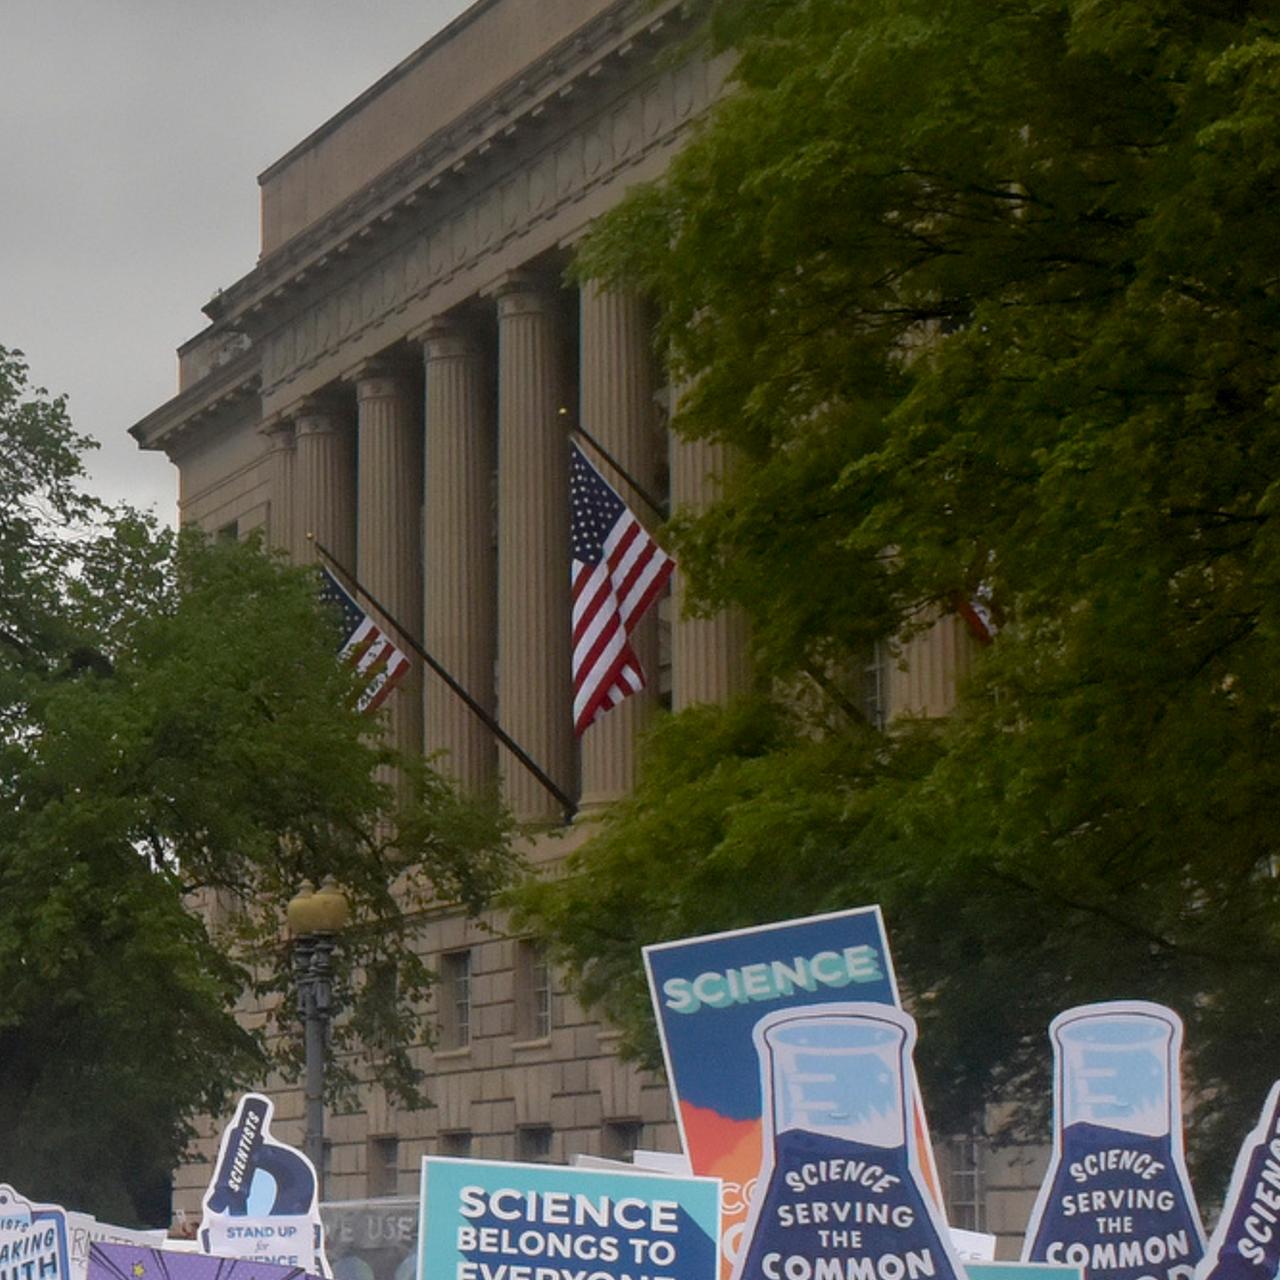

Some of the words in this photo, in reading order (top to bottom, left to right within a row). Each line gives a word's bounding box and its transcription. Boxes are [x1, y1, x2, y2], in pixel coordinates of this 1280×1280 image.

[663, 944, 880, 1010] SCIENCE
[228, 1110, 261, 1194] SCIENTISTS
[1069, 1149, 1165, 1183] SCIENCE
[785, 1158, 901, 1194] SCIENCE
[1237, 1118, 1280, 1265] SCIEN
[458, 1185, 679, 1233] SCIENCE
[777, 1200, 915, 1229] SERVING
[1061, 1190, 1175, 1216] SERVING
[226, 1226, 275, 1239] STAND
[278, 1226, 297, 1238] UP
[817, 1230, 863, 1249] THE
[1096, 1217, 1133, 1233] THE
[456, 1226, 620, 1262] BELONGS
[629, 1239, 677, 1266] TO
[1045, 1231, 1190, 1270] COMMON
